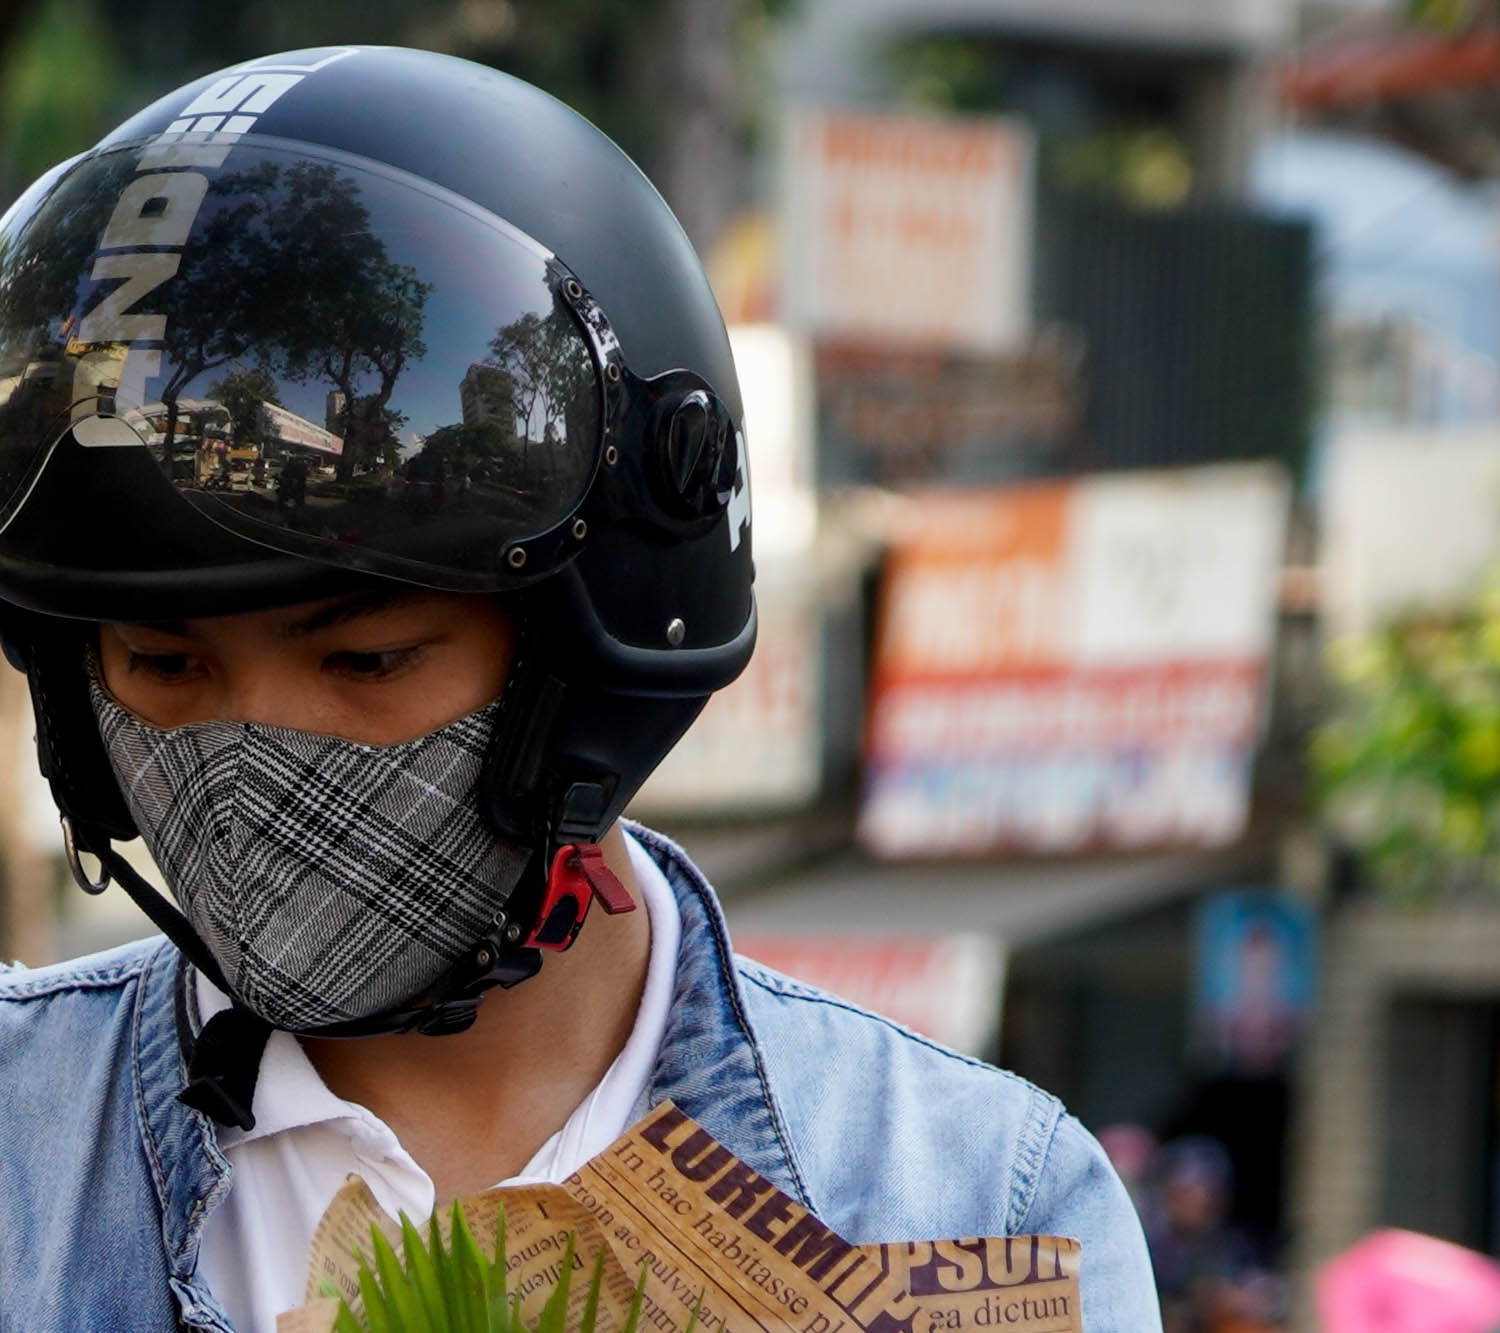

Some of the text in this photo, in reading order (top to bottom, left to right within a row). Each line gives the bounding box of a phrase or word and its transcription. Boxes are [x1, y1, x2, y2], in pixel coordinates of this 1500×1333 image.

[561, 1171, 615, 1226] Proin
[614, 1226, 640, 1249] ac
[634, 1248, 721, 1330] pulvinar
[613, 1140, 644, 1173] In
[645, 1167, 692, 1215] hac
[692, 1211, 809, 1315] habitasse
